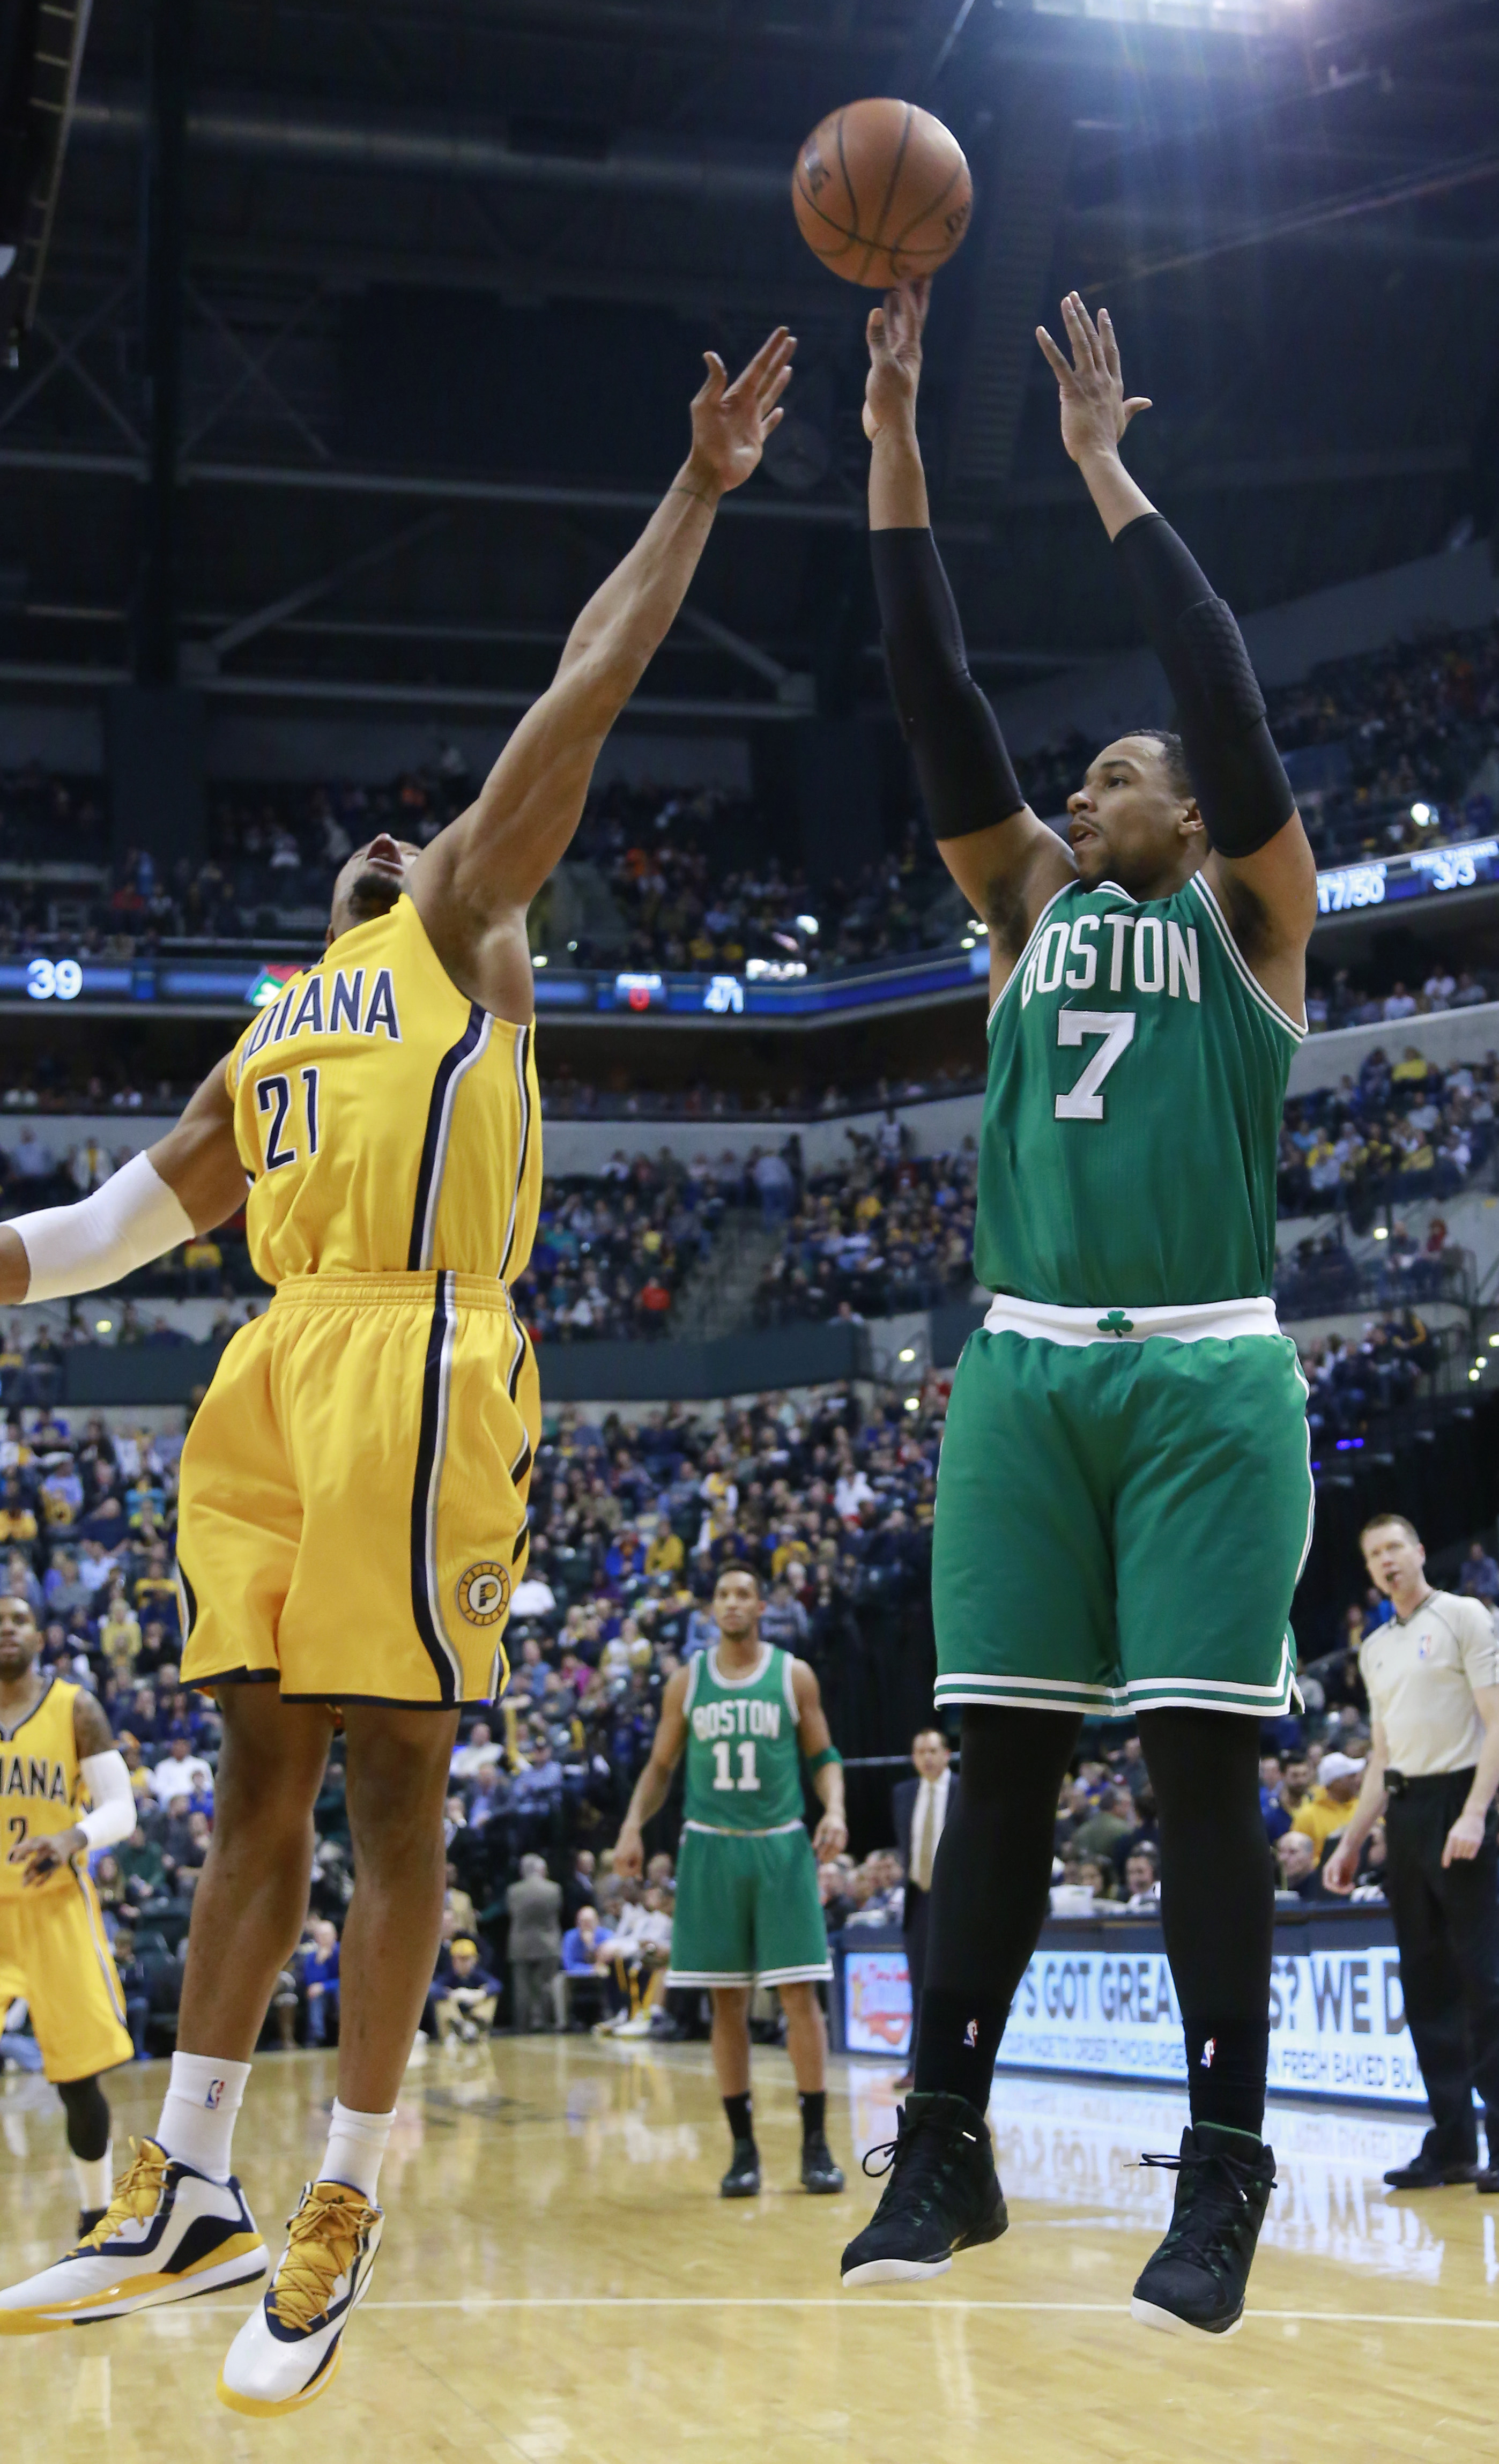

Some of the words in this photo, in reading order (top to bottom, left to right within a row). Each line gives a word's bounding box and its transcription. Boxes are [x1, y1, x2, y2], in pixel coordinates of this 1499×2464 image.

[27, 958, 83, 1000] 39
[1021, 914, 1201, 1010] BOSTON
[238, 968, 403, 1080] DIANA
[1055, 1009, 1137, 1119] 7
[255, 1066, 320, 1172] 21
[692, 1698, 781, 1742] BOSTON
[712, 1741, 761, 1791] 11
[8, 1815, 28, 1864] 2
[1045, 1961, 1090, 2020] GOT
[1101, 1961, 1176, 2024] GREA
[1310, 1959, 1371, 2034] WE
[1383, 1960, 1408, 2034] D
[1283, 2050, 1330, 2082] FRESH
[1334, 2053, 1385, 2087] BAKED
